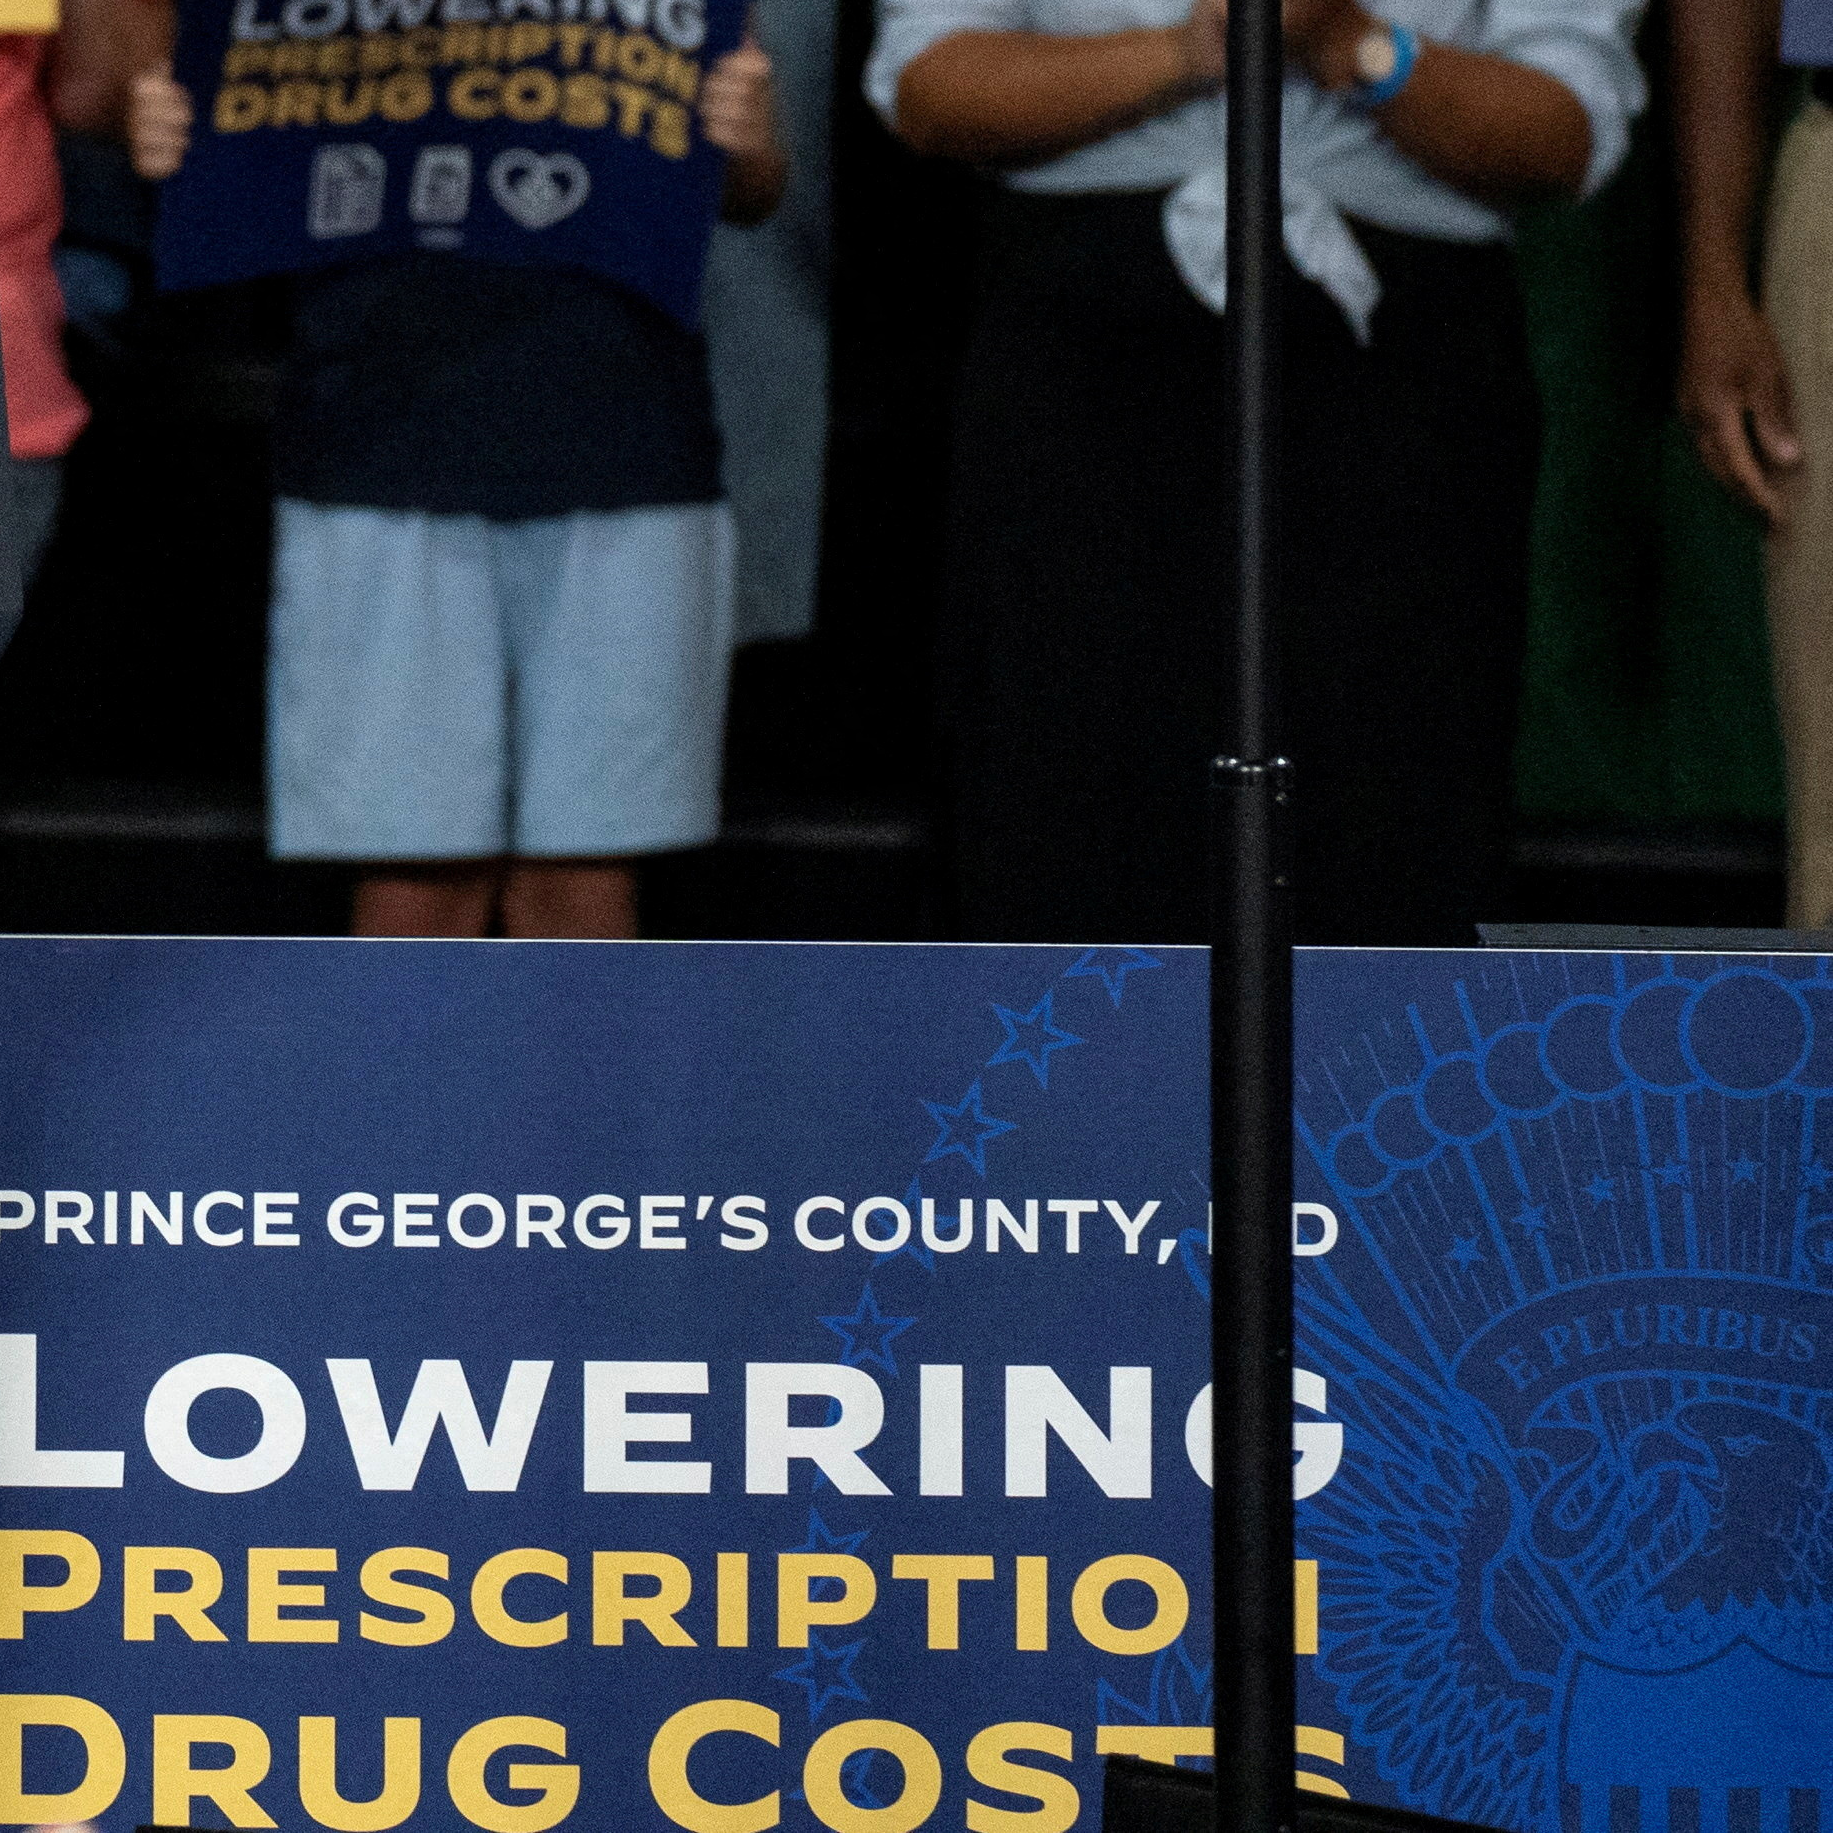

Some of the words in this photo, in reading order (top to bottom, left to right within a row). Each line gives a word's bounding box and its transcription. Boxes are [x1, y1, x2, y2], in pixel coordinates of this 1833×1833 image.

[213, 69, 434, 134] DRUG
[326, 1191, 770, 1251] GEORGE'S
[793, 1195, 1181, 1265] COUNTY,
[1495, 1344, 1542, 1392] E
[1540, 1303, 1822, 1364] PLURIBUS
